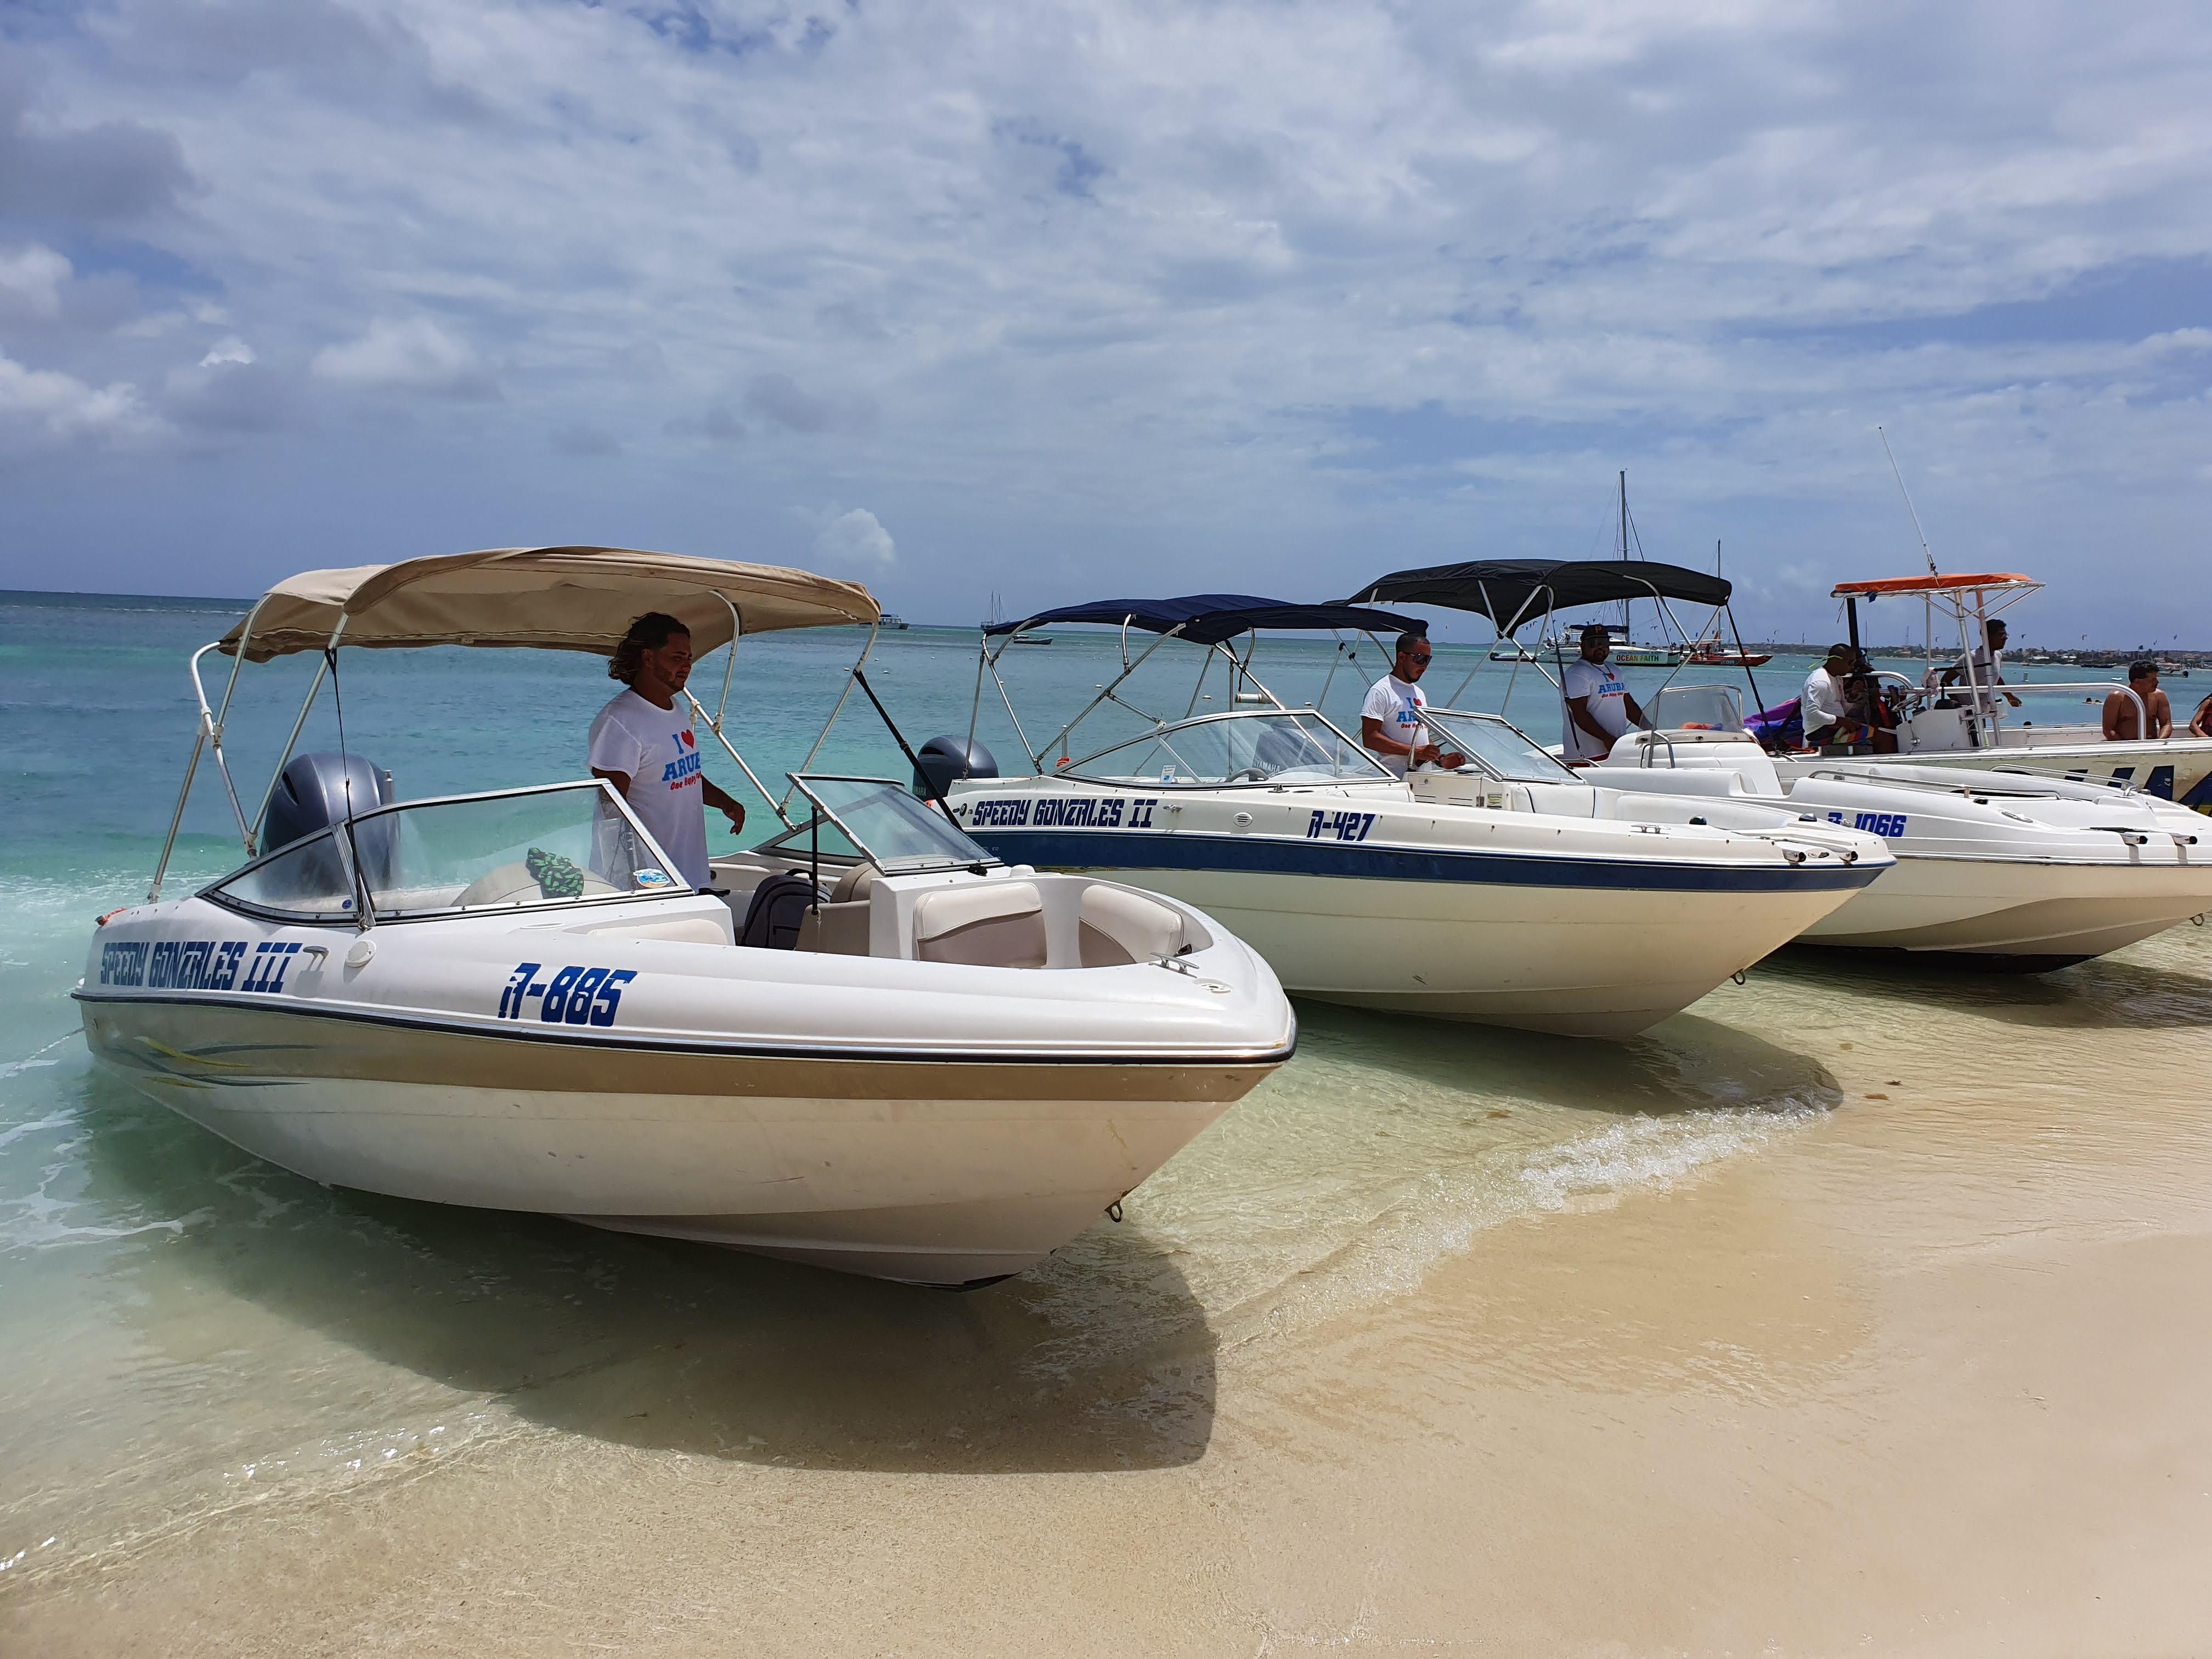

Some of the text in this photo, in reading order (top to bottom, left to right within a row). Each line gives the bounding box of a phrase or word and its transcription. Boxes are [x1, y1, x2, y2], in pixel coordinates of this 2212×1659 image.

[1598, 682, 1625, 693] ARUBA
[672, 733, 684, 754] I
[662, 752, 701, 781] ARUB
[1257, 760, 1280, 772] YAMAHA
[670, 782, 683, 790] One
[972, 799, 1158, 827] SPEEDY GONZALES II
[1306, 810, 1376, 842] R-427
[100, 941, 303, 993] SPEEDY GONZALES III
